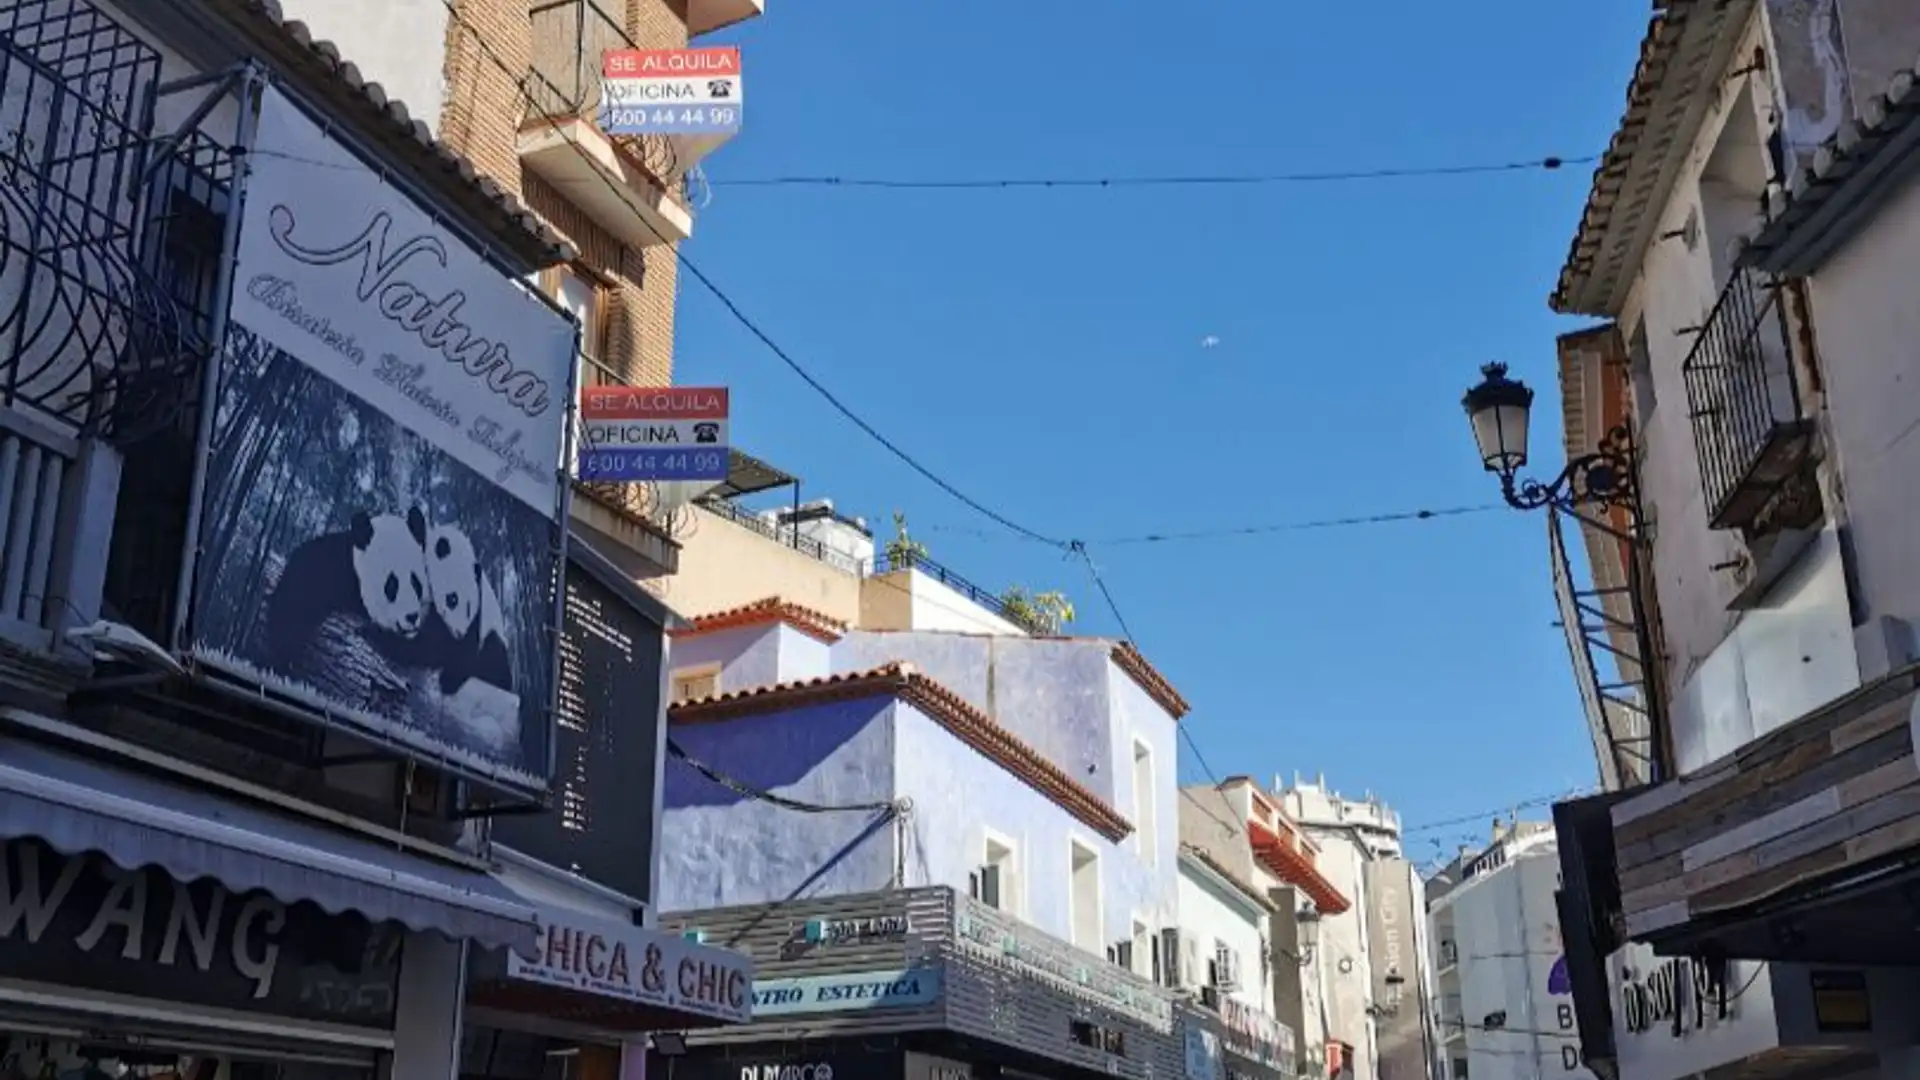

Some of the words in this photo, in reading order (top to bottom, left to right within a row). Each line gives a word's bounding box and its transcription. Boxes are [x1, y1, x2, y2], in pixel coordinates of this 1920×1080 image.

[610, 56, 637, 72] SE
[642, 53, 733, 72] ALQUILA
[611, 82, 696, 99] OFICINA
[652, 109, 675, 125] 44
[680, 109, 704, 125] 44
[710, 107, 734, 125] 99
[269, 203, 549, 417] Natura
[590, 393, 619, 411] SE
[624, 393, 721, 411] ALQUILA
[588, 423, 680, 443] OFICINA
[587, 454, 625, 472] 600
[631, 454, 656, 471] 44
[663, 454, 687, 471] 44
[694, 453, 720, 472] 99
[0, 842, 286, 999] WANG
[532, 923, 631, 984] HICA
[640, 941, 667, 994] &
[677, 956, 747, 1010] CHIC
[816, 977, 922, 1002] ESTETICA
